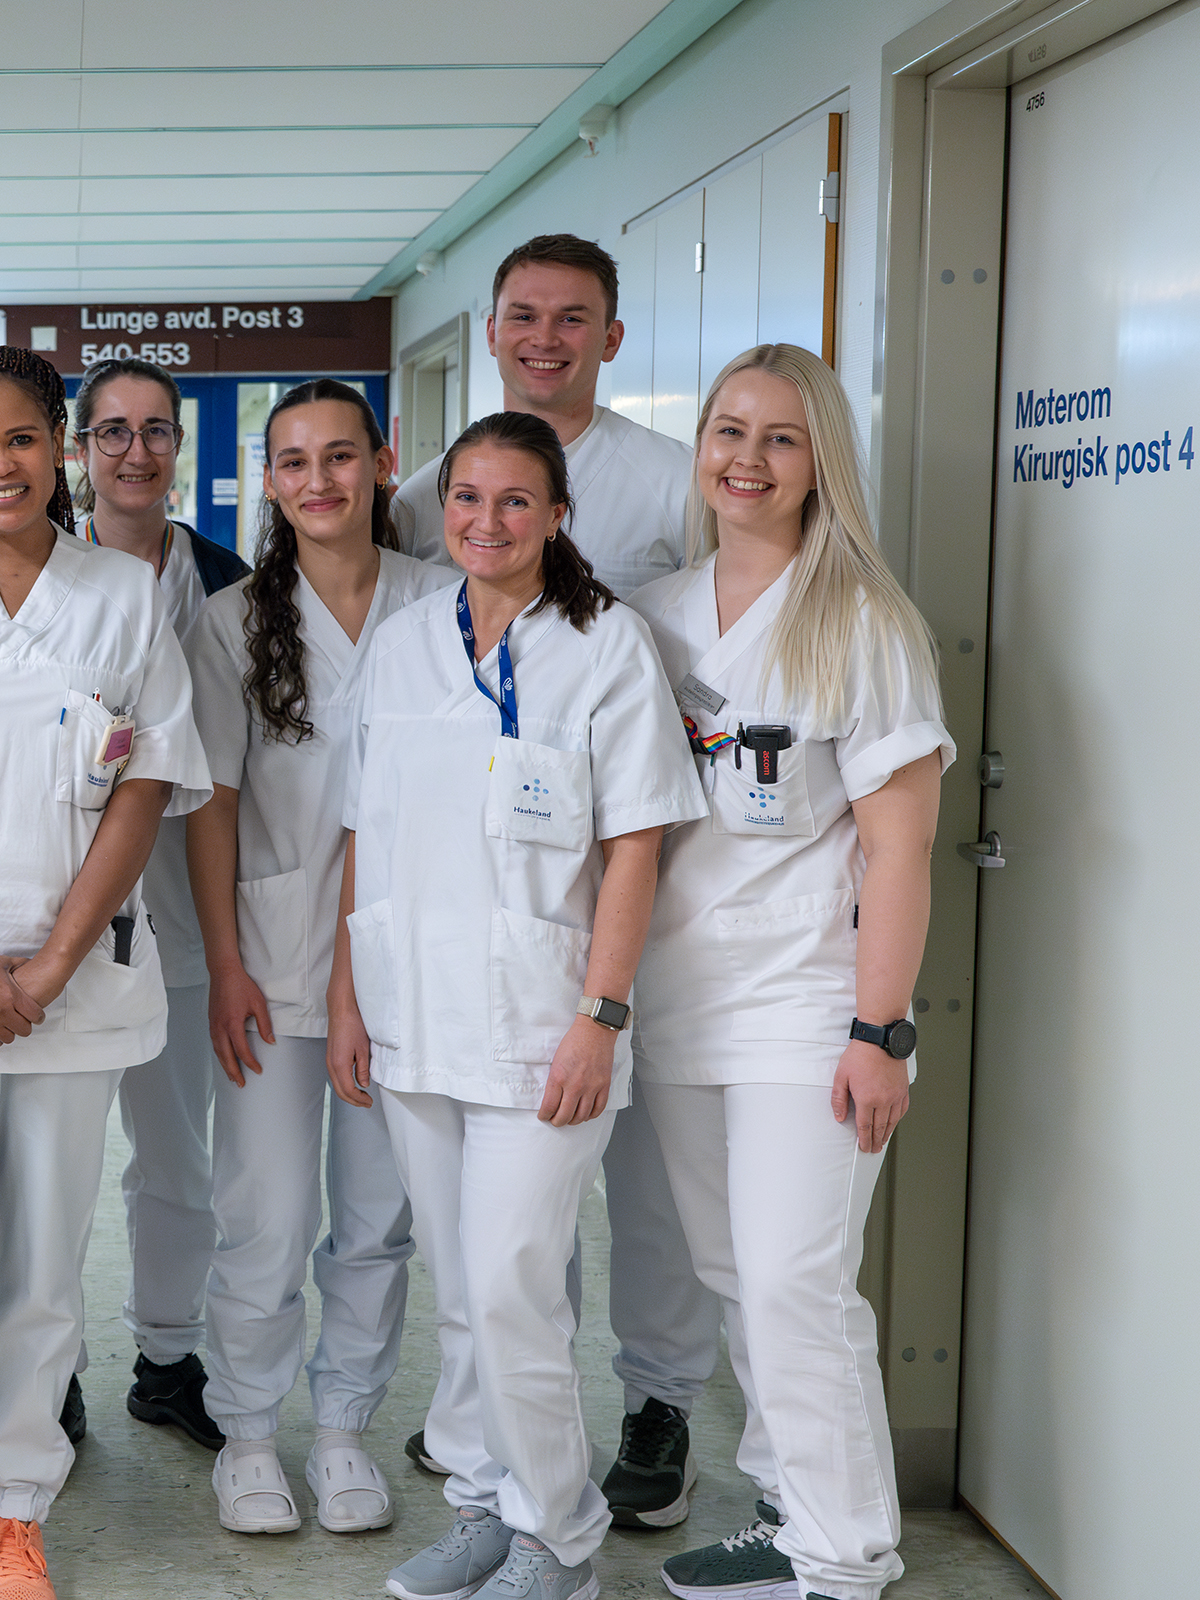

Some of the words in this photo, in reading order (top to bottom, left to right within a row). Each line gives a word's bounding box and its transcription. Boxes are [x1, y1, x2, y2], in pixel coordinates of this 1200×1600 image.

[1026, 91, 1045, 112] 4756
[81, 307, 159, 335] Lunge
[164, 306, 217, 330] avd.
[222, 306, 282, 329] Post
[287, 306, 304, 328] 3
[1015, 387, 1112, 430] Møterom
[1013, 435, 1109, 489] Kirurgisk
[1115, 430, 1172, 485] post
[1178, 426, 1195, 470] 4
[762, 750, 770, 776] ascom
[513, 806, 552, 818] Haukeland
